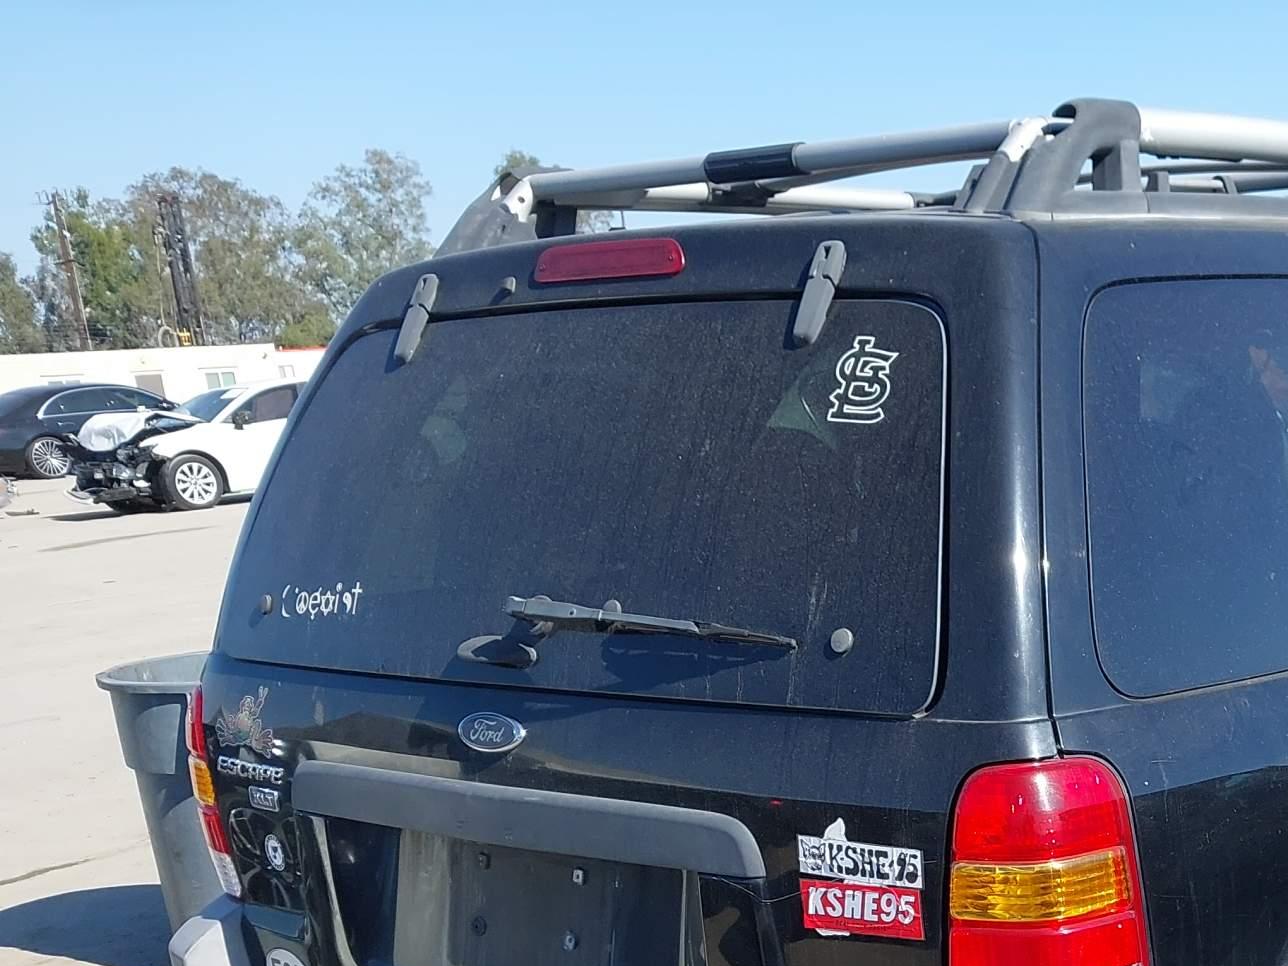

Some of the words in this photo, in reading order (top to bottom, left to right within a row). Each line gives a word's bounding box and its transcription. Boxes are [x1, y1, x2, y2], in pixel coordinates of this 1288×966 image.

[470, 718, 505, 742] Ford
[217, 755, 284, 785] ESCAPE
[807, 886, 915, 925] KSHE95
